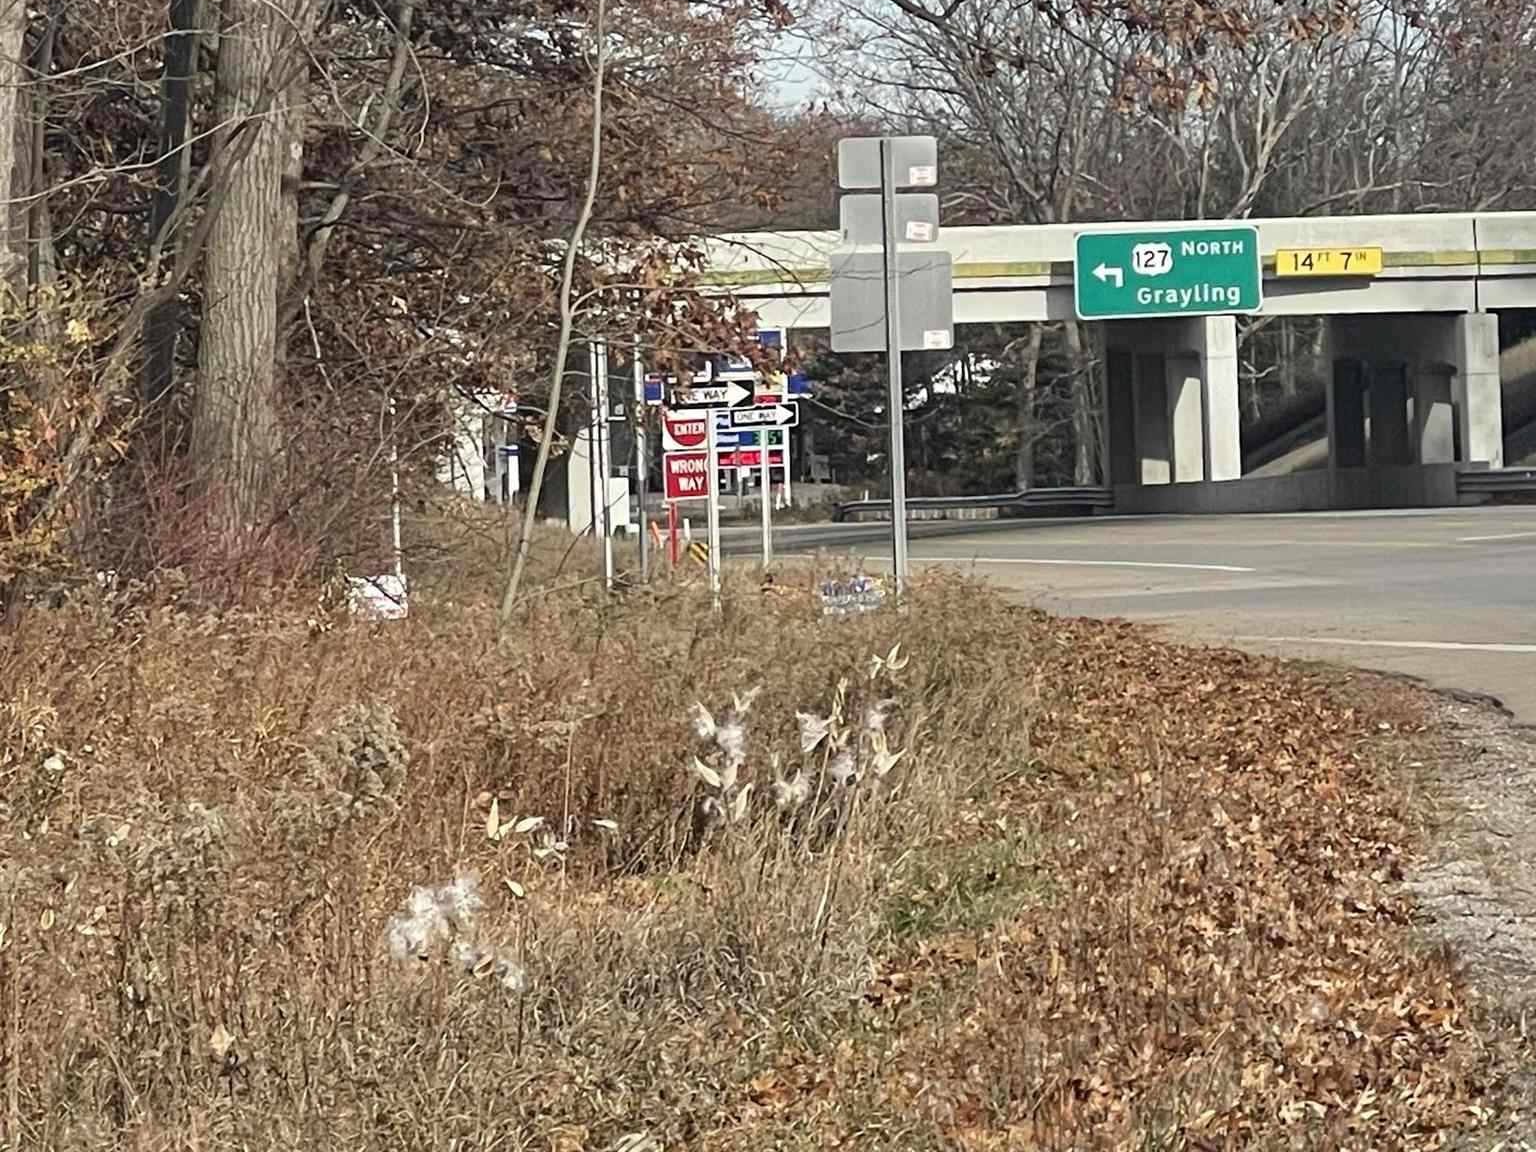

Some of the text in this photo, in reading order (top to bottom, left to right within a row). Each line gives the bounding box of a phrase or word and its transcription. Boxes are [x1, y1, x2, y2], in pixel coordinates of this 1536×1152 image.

[1135, 241, 1244, 268] 127 NORTH
[1293, 252, 1313, 271] 14
[1317, 251, 1330, 262] FT
[1340, 252, 1353, 271] 7
[1137, 284, 1241, 307] Grayling
[704, 388, 728, 400] WAY
[737, 410, 777, 421] ONE WAY
[674, 422, 705, 436] ENTER
[678, 476, 705, 492] WAY
